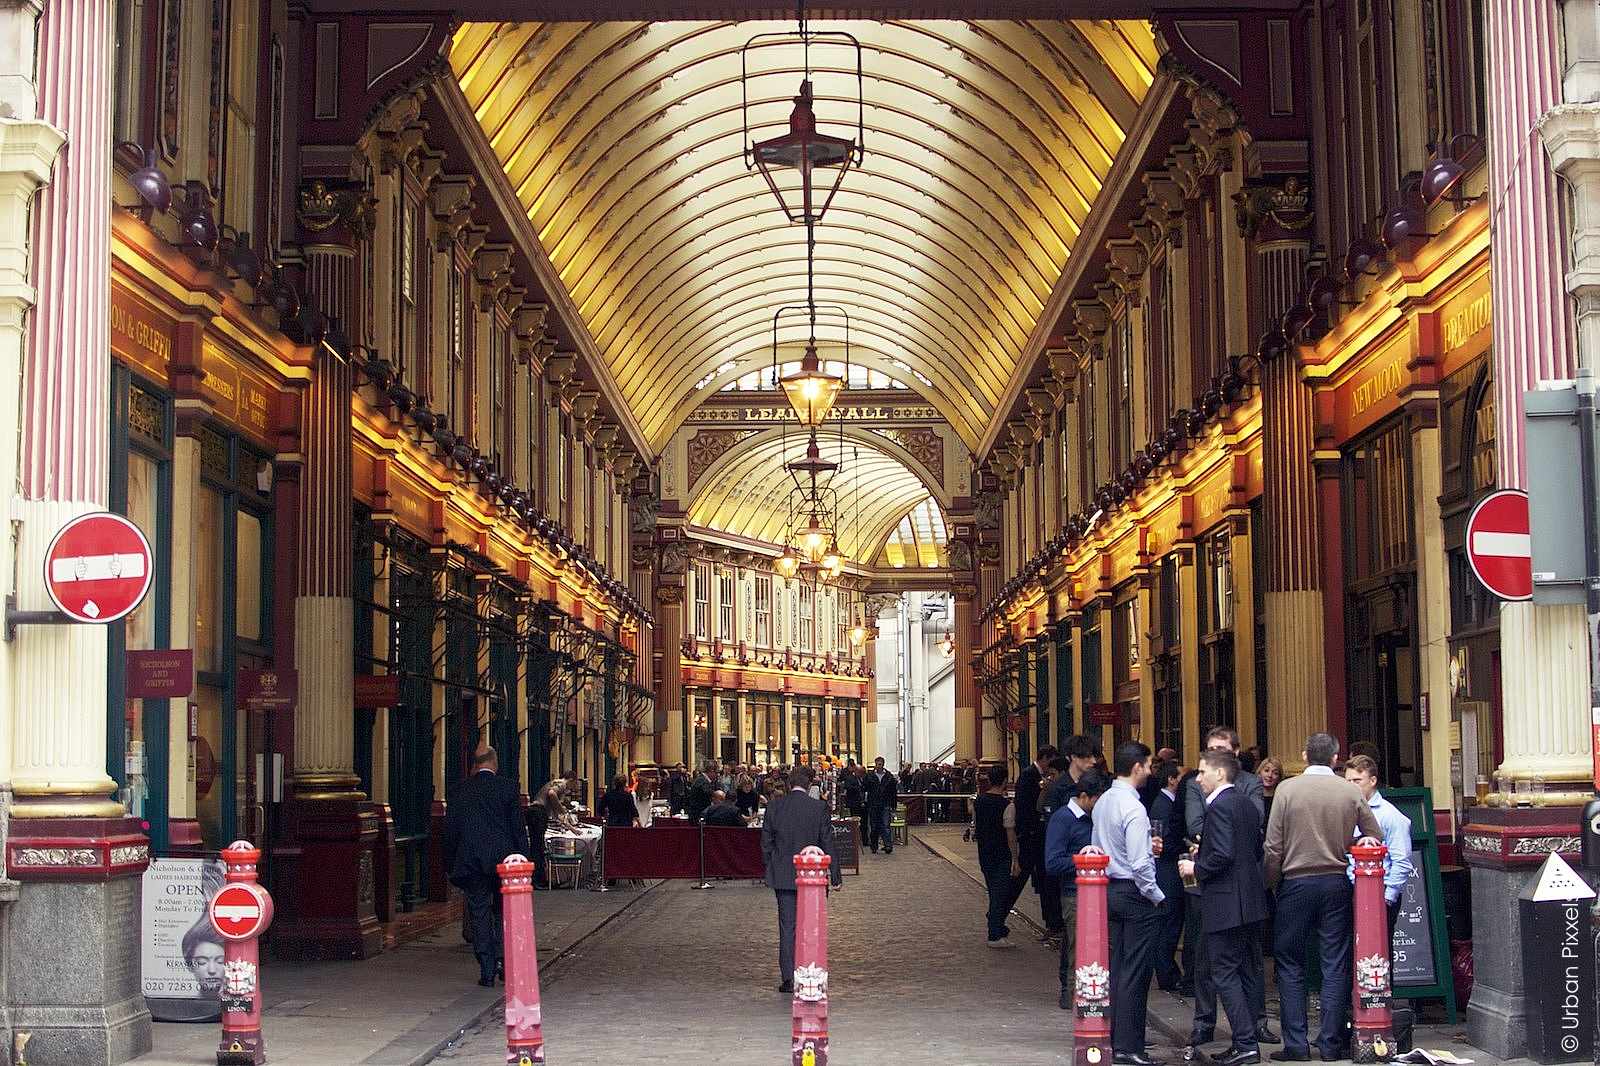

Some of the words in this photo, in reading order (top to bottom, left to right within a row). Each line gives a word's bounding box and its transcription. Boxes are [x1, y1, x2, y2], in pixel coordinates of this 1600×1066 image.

[1352, 378, 1375, 417] NEW
[1373, 358, 1405, 404] MOON
[152, 671, 169, 679] AND
[166, 884, 205, 896] OPEN
[168, 982, 193, 991] 7283
